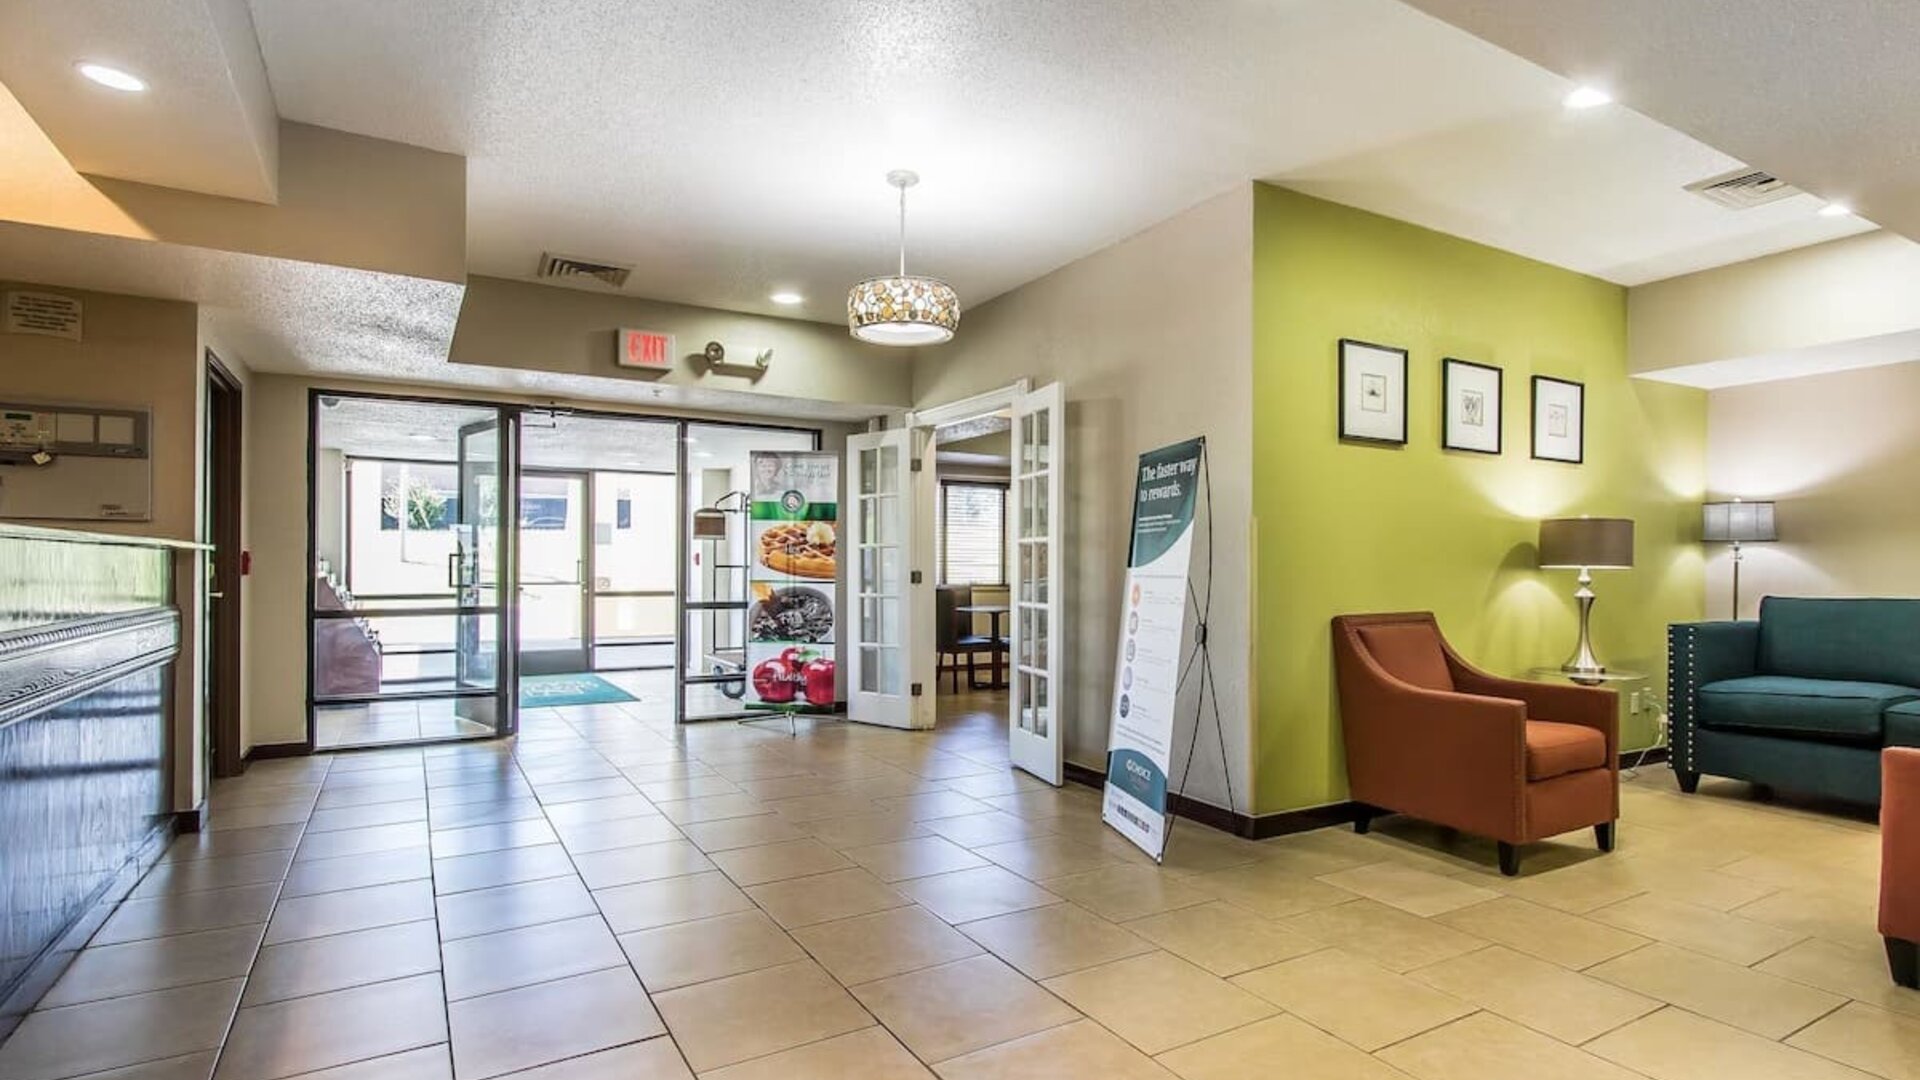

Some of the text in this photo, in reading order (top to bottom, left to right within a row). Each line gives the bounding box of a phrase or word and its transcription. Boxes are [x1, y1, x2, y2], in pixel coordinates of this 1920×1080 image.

[628, 331, 667, 364] EXIT
[1142, 458, 1198, 482] The faster way
[1141, 489, 1148, 502] to
